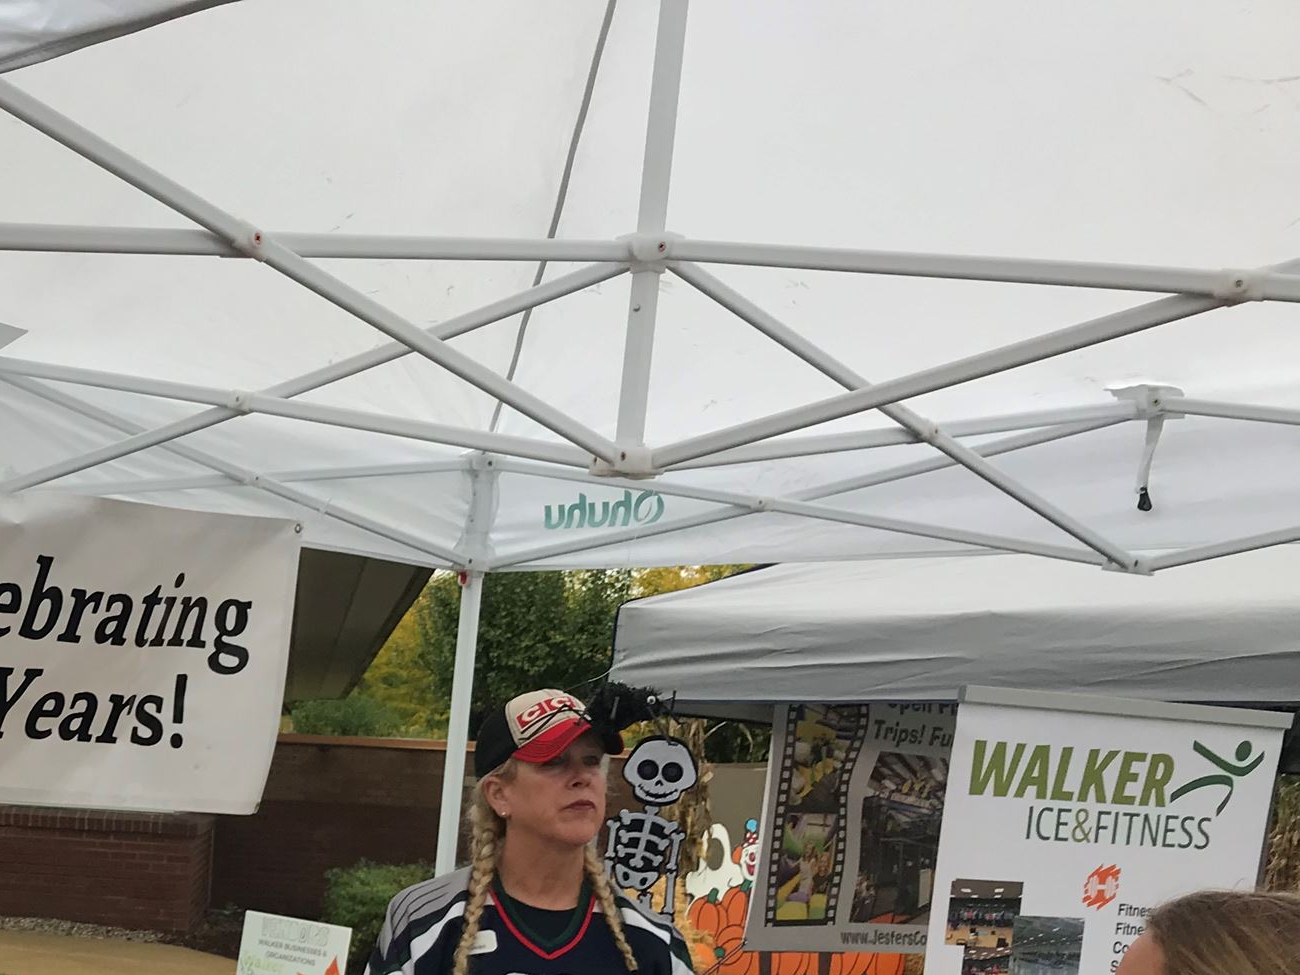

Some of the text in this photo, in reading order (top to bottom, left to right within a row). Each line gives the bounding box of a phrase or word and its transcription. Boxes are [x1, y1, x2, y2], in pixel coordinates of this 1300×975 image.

[874, 719, 952, 748] Trips! Fu
[968, 739, 1174, 807] WALKER
[1025, 806, 1213, 851] ICE&FITNESS
[840, 929, 928, 945] www.JestersCo
[1115, 922, 1145, 936] Fitne
